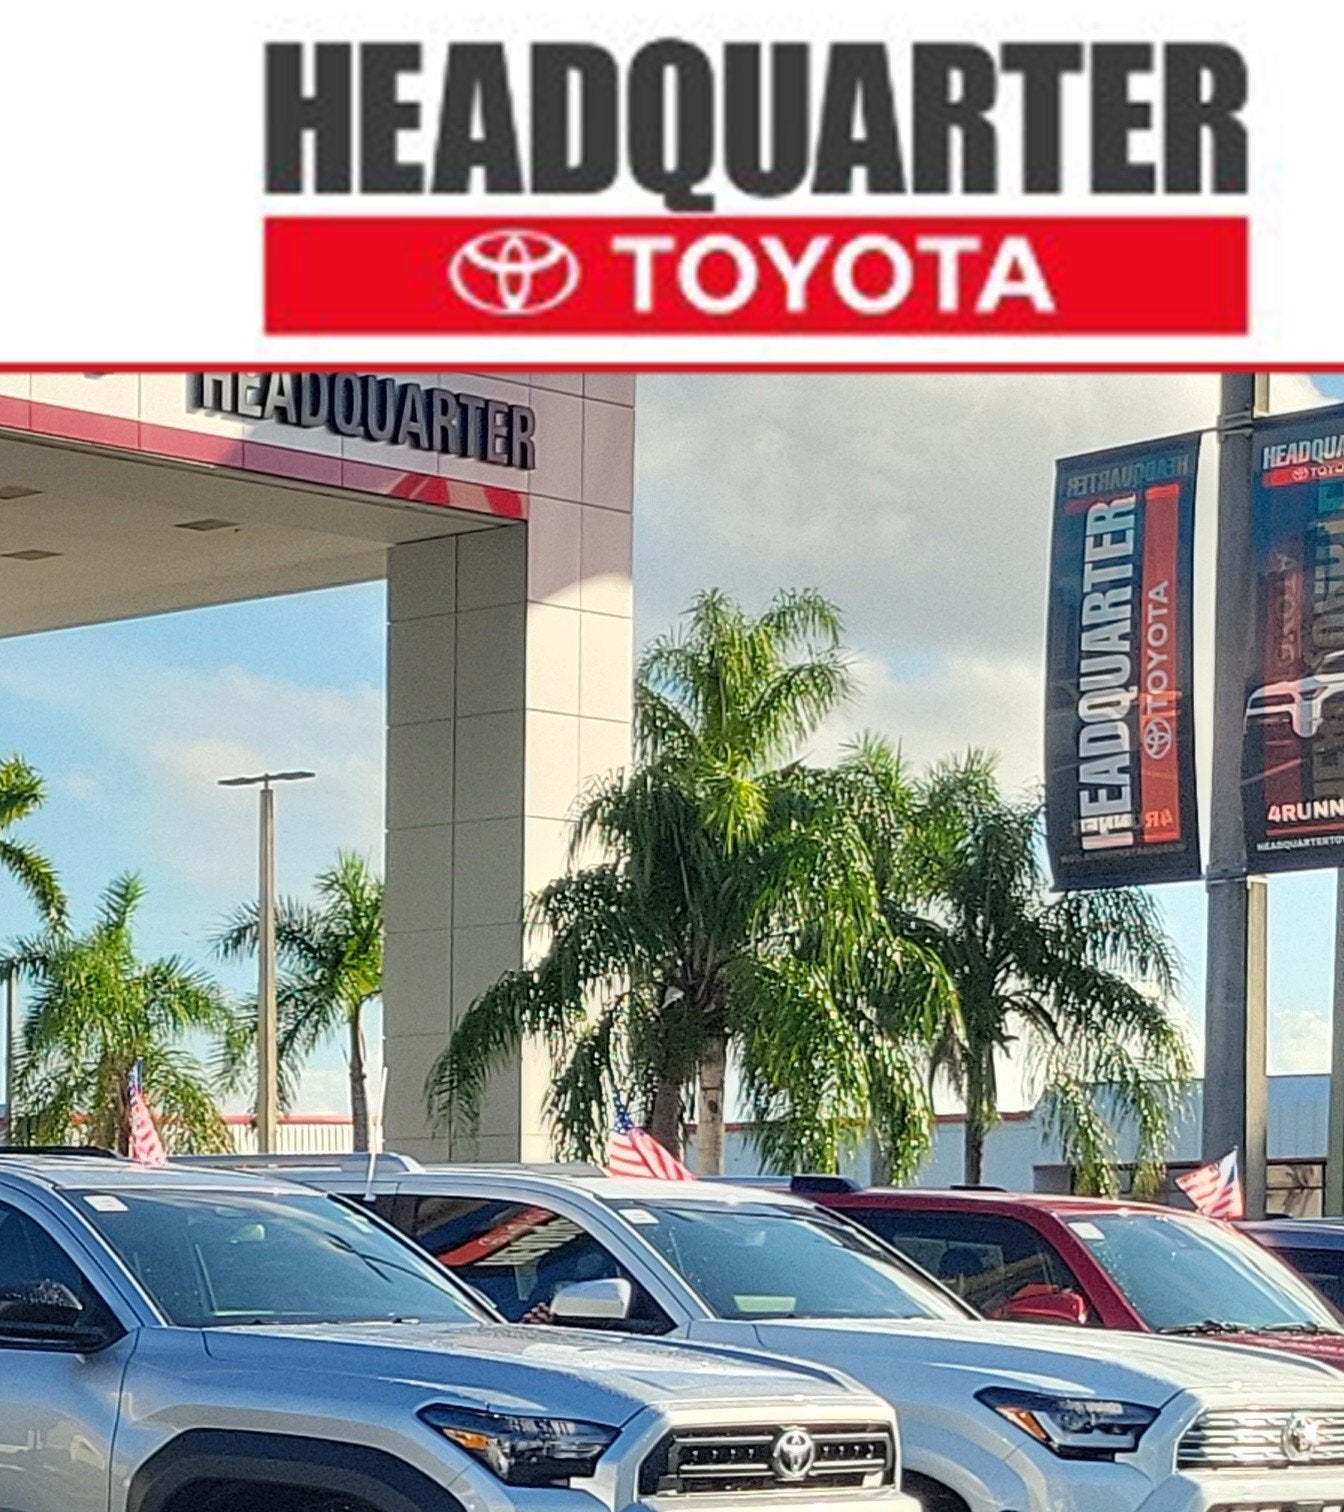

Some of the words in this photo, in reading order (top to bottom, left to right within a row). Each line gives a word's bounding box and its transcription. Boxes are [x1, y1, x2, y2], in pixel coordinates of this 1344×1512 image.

[198, 372, 536, 469] HEADQUARTER
[1079, 491, 1137, 851] HEADQUARTER
[1146, 580, 1169, 716] TOYOTA
[1267, 798, 1344, 823] 4RUNN
